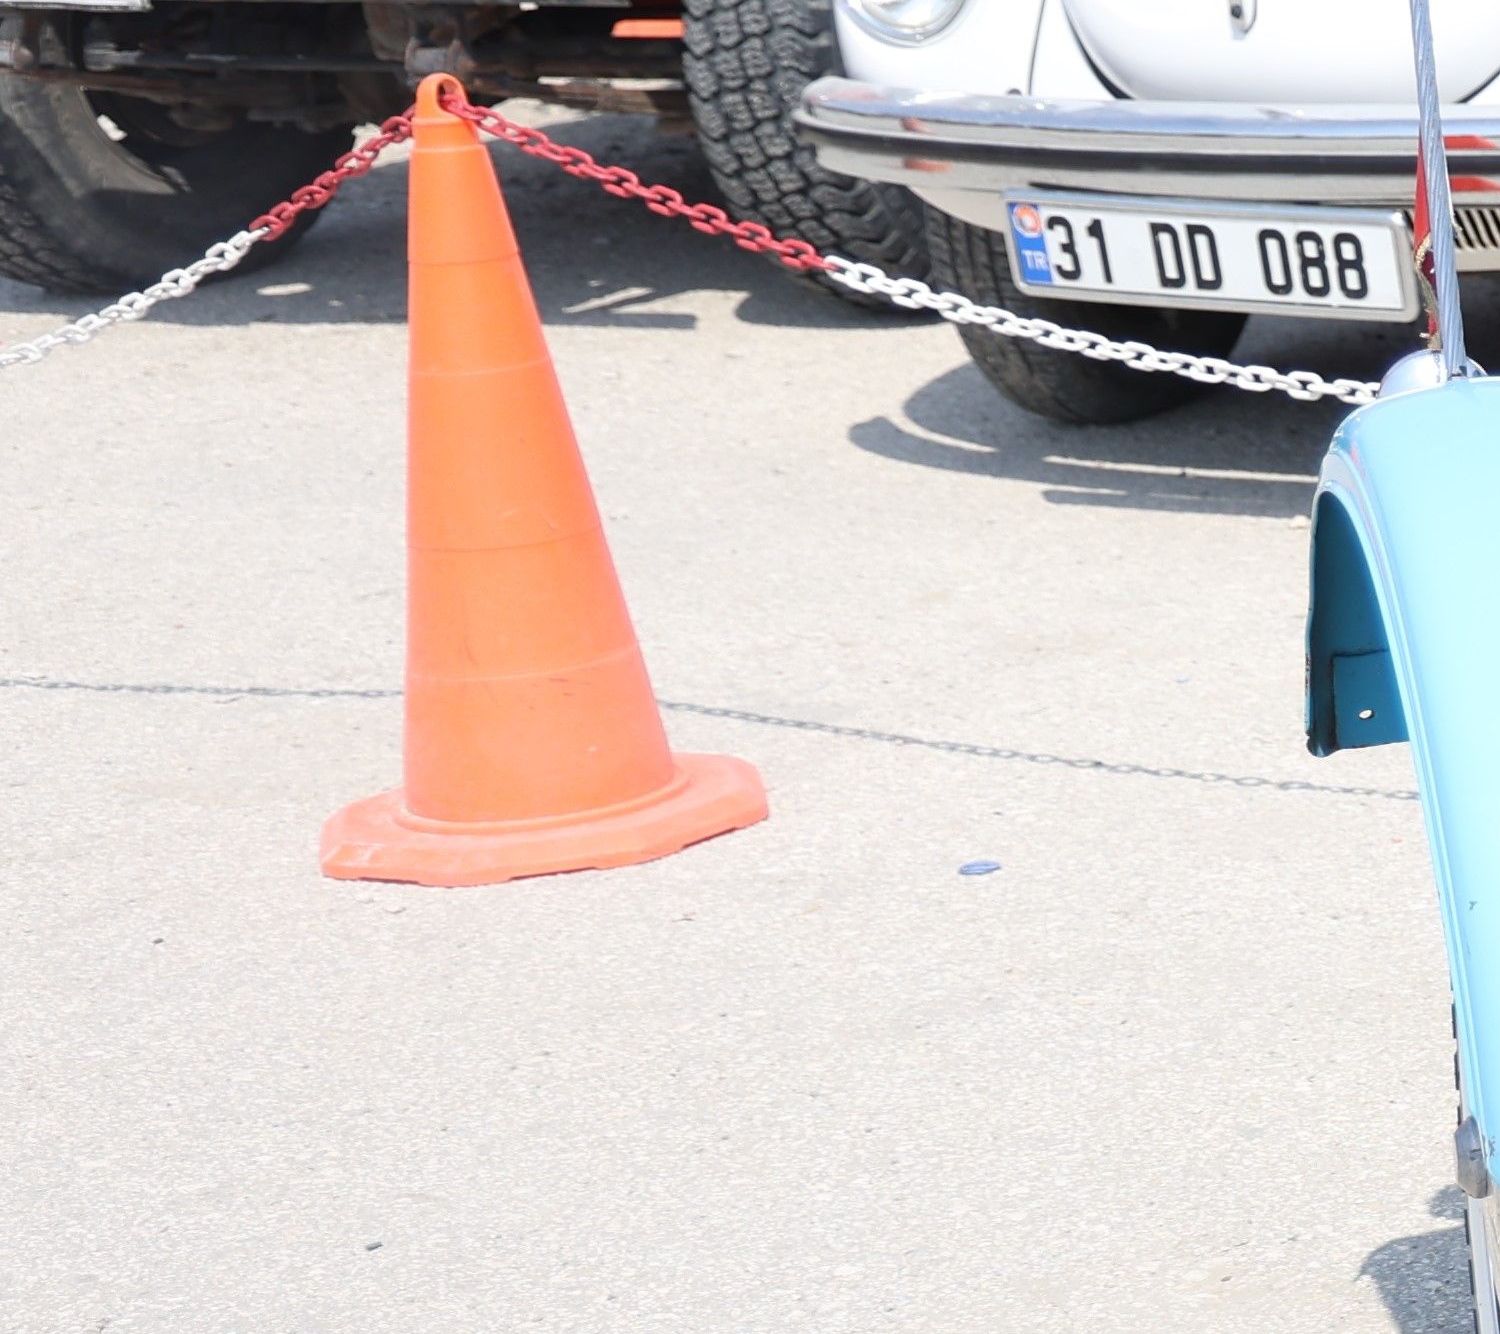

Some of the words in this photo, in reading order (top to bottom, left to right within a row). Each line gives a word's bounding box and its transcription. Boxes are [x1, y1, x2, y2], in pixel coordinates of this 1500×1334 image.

[1021, 250, 1048, 270] TR
[1047, 215, 1113, 283] 31
[1149, 222, 1222, 290] DD
[1258, 228, 1368, 299] 088
